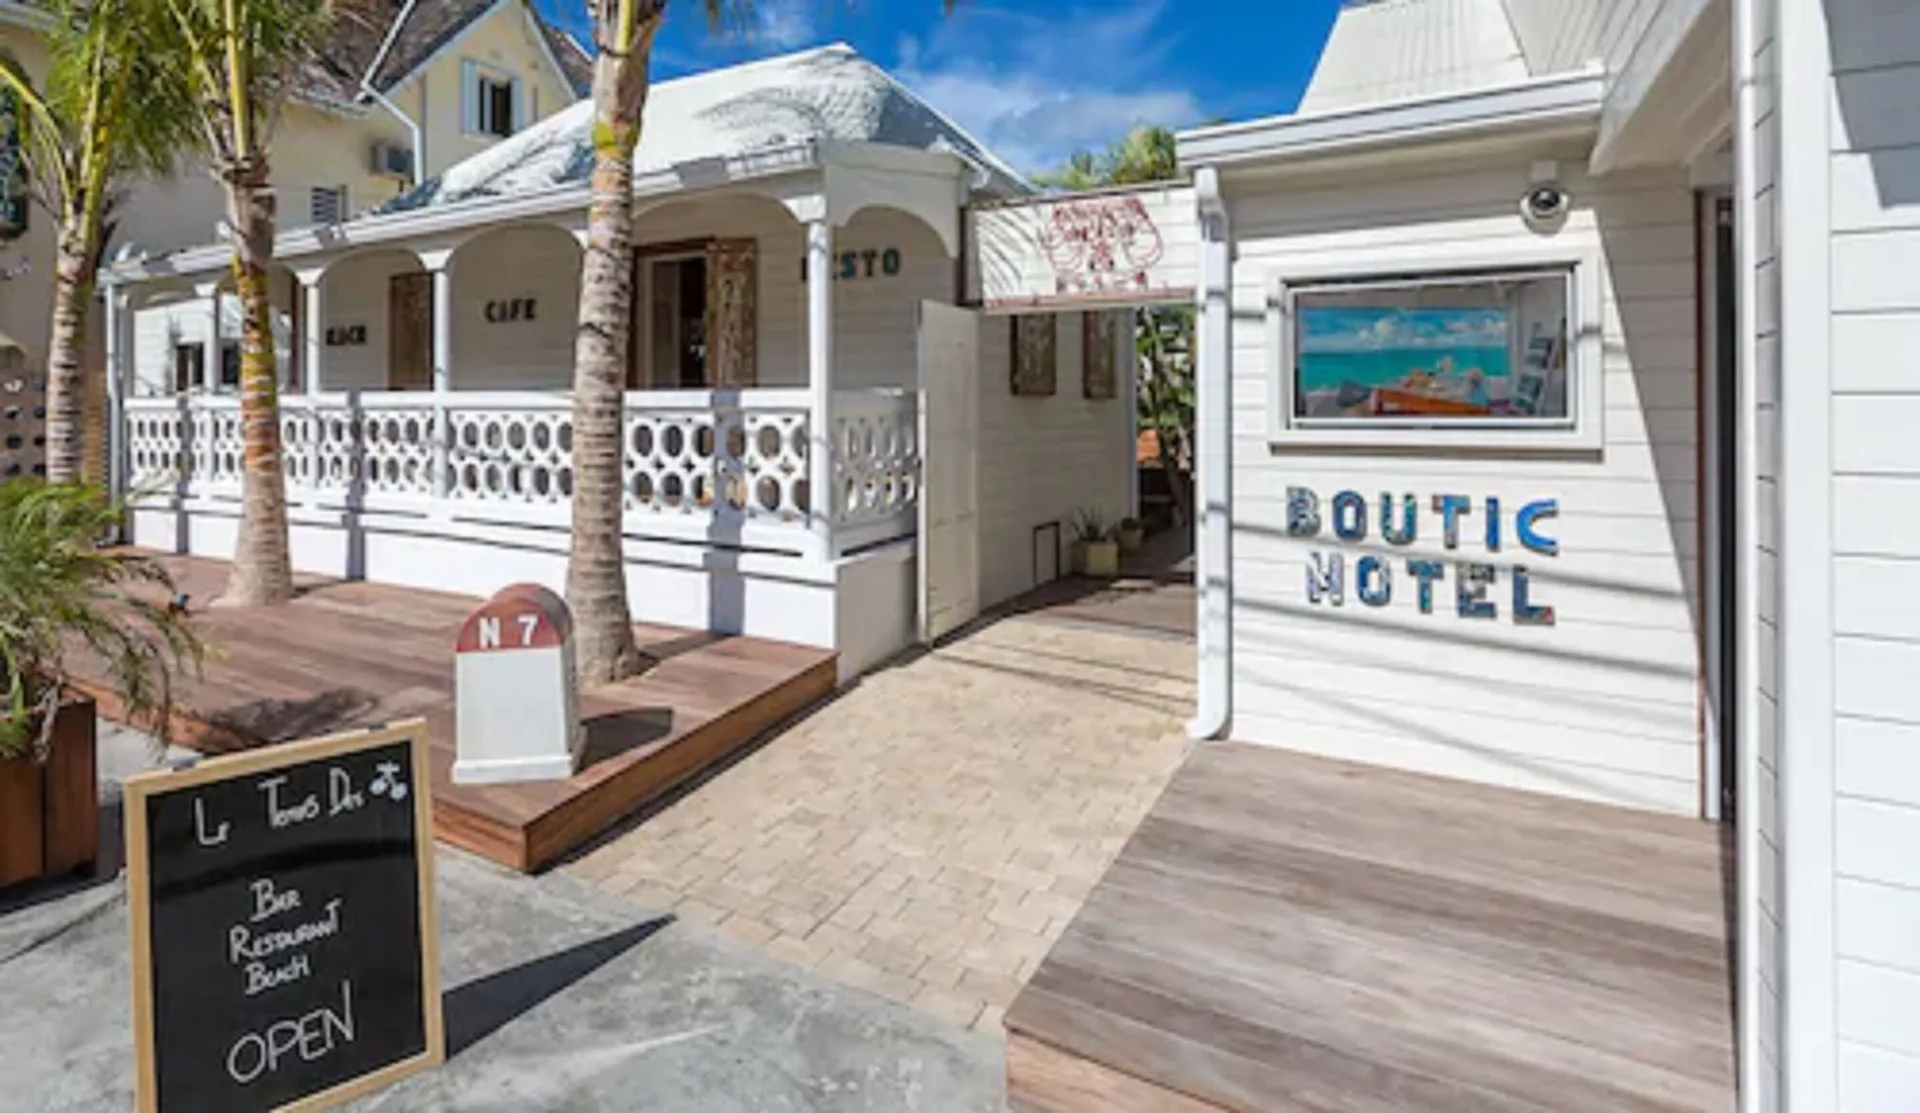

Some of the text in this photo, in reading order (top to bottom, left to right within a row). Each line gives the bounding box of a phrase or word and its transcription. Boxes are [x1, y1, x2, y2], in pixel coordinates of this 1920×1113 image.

[1286, 486, 1559, 557] BOUTIC
[1306, 551, 1555, 627] HOTEL
[479, 614, 539, 649] N 7
[226, 979, 354, 1083] OPEN
